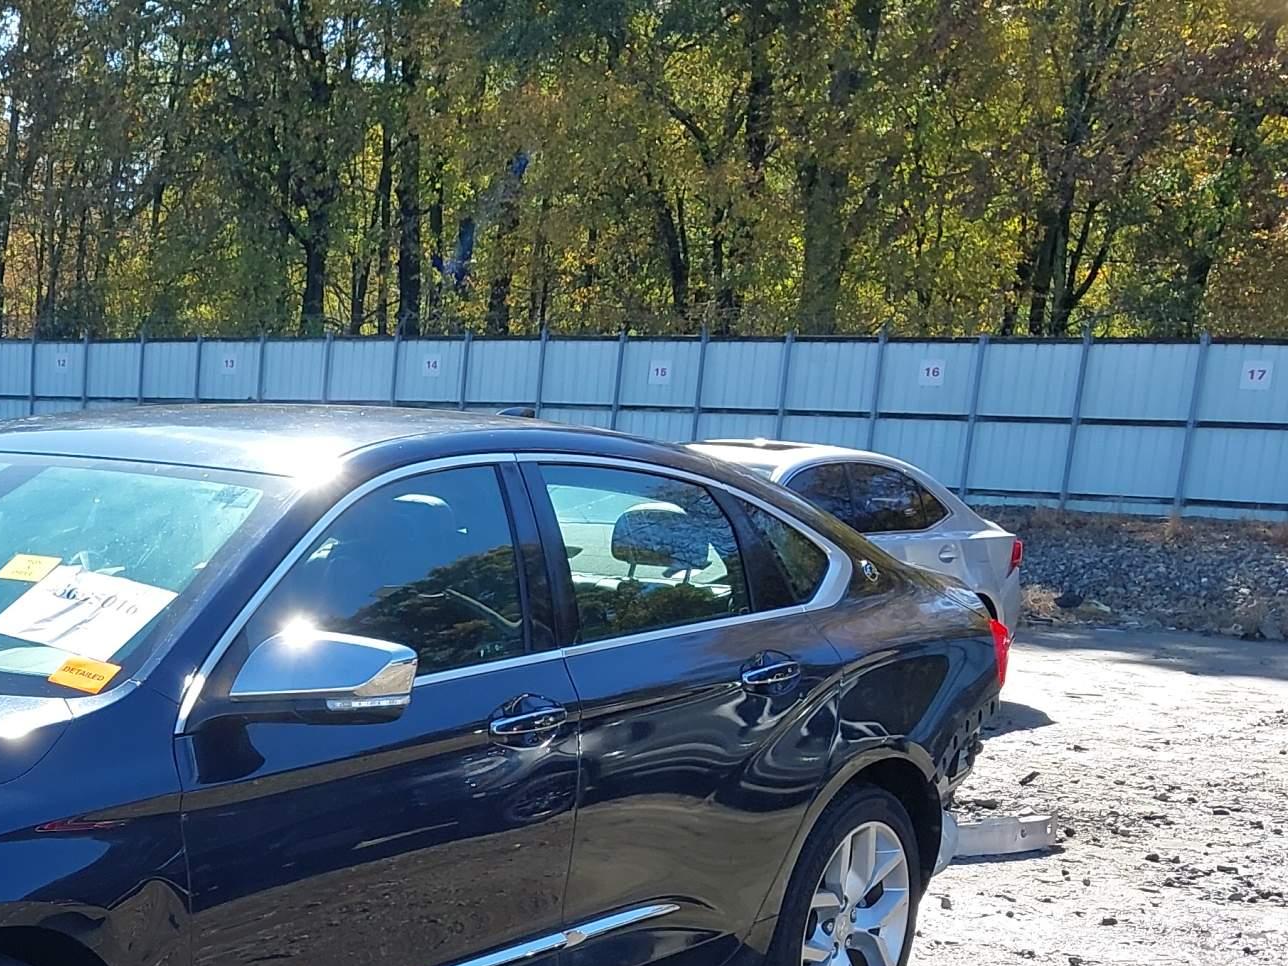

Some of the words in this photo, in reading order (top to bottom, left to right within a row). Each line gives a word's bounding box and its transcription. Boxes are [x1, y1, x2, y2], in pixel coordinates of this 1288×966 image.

[655, 367, 667, 377] 15
[925, 367, 940, 377] 16
[1247, 369, 1267, 380] 17
[62, 665, 105, 682] DETAILED
